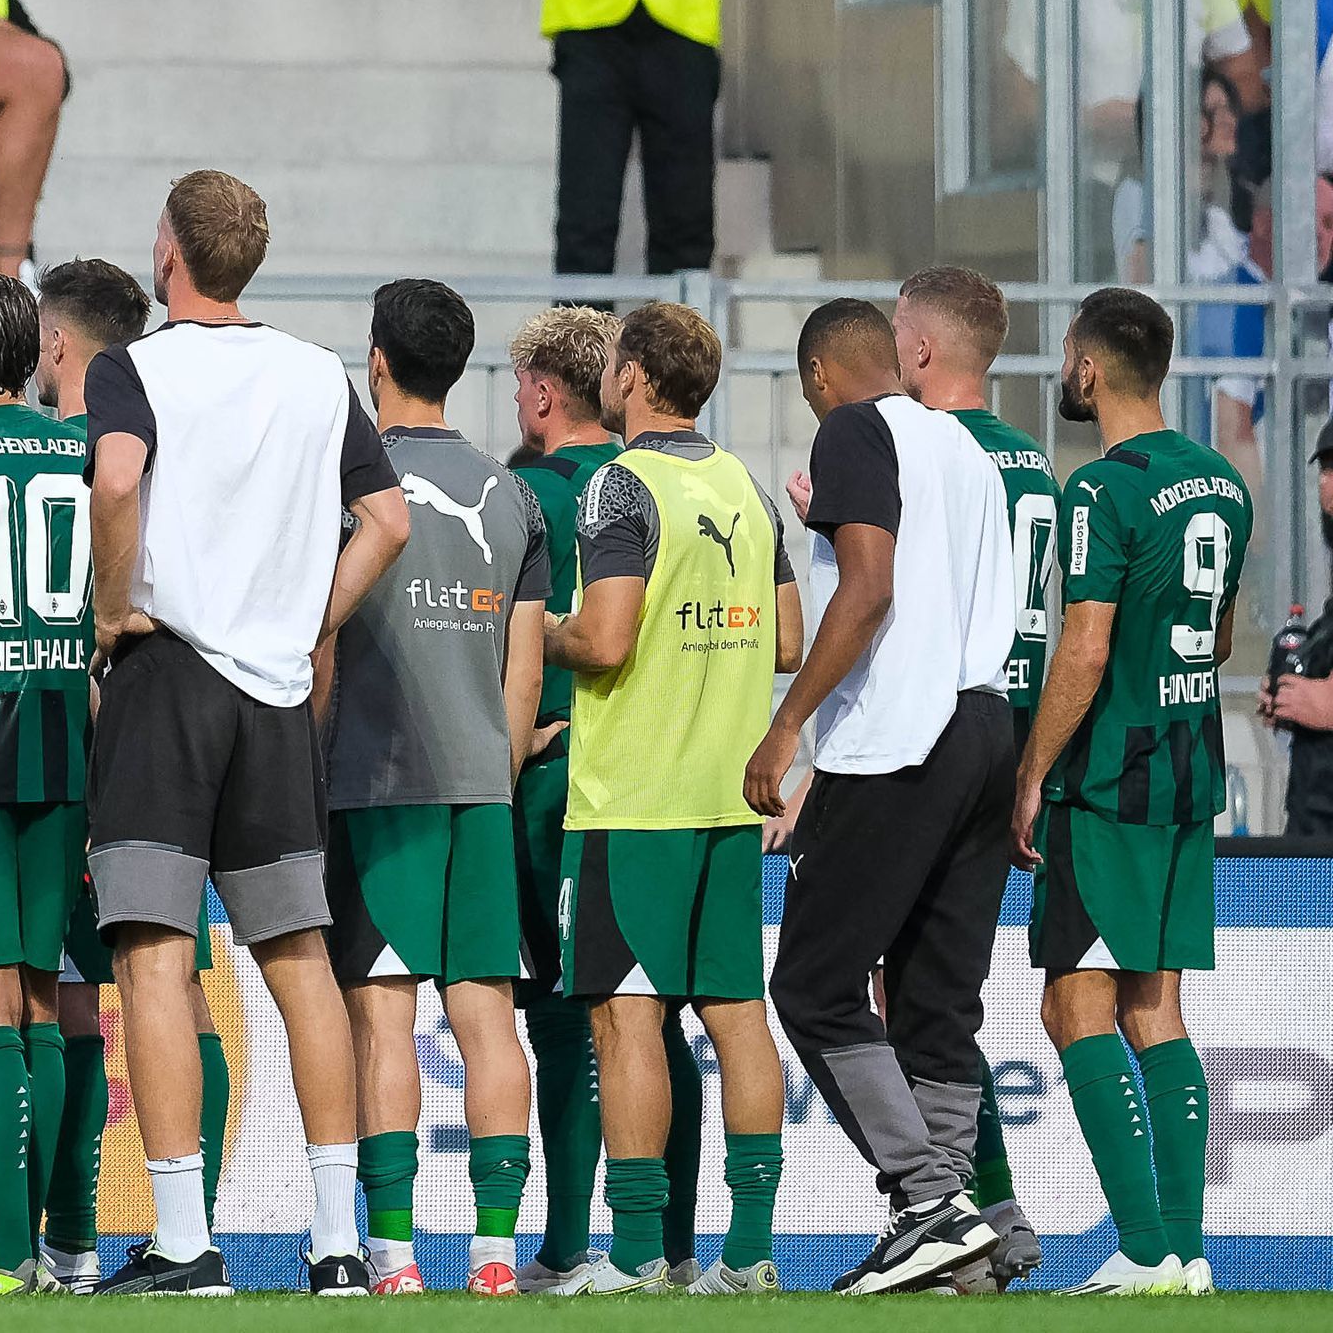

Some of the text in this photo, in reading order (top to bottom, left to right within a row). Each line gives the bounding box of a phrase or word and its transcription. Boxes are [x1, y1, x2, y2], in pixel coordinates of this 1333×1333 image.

[1074, 524, 1084, 572] sonepar
[1170, 513, 1233, 663] 9
[463, 620, 483, 633] den
[721, 639, 739, 650] den
